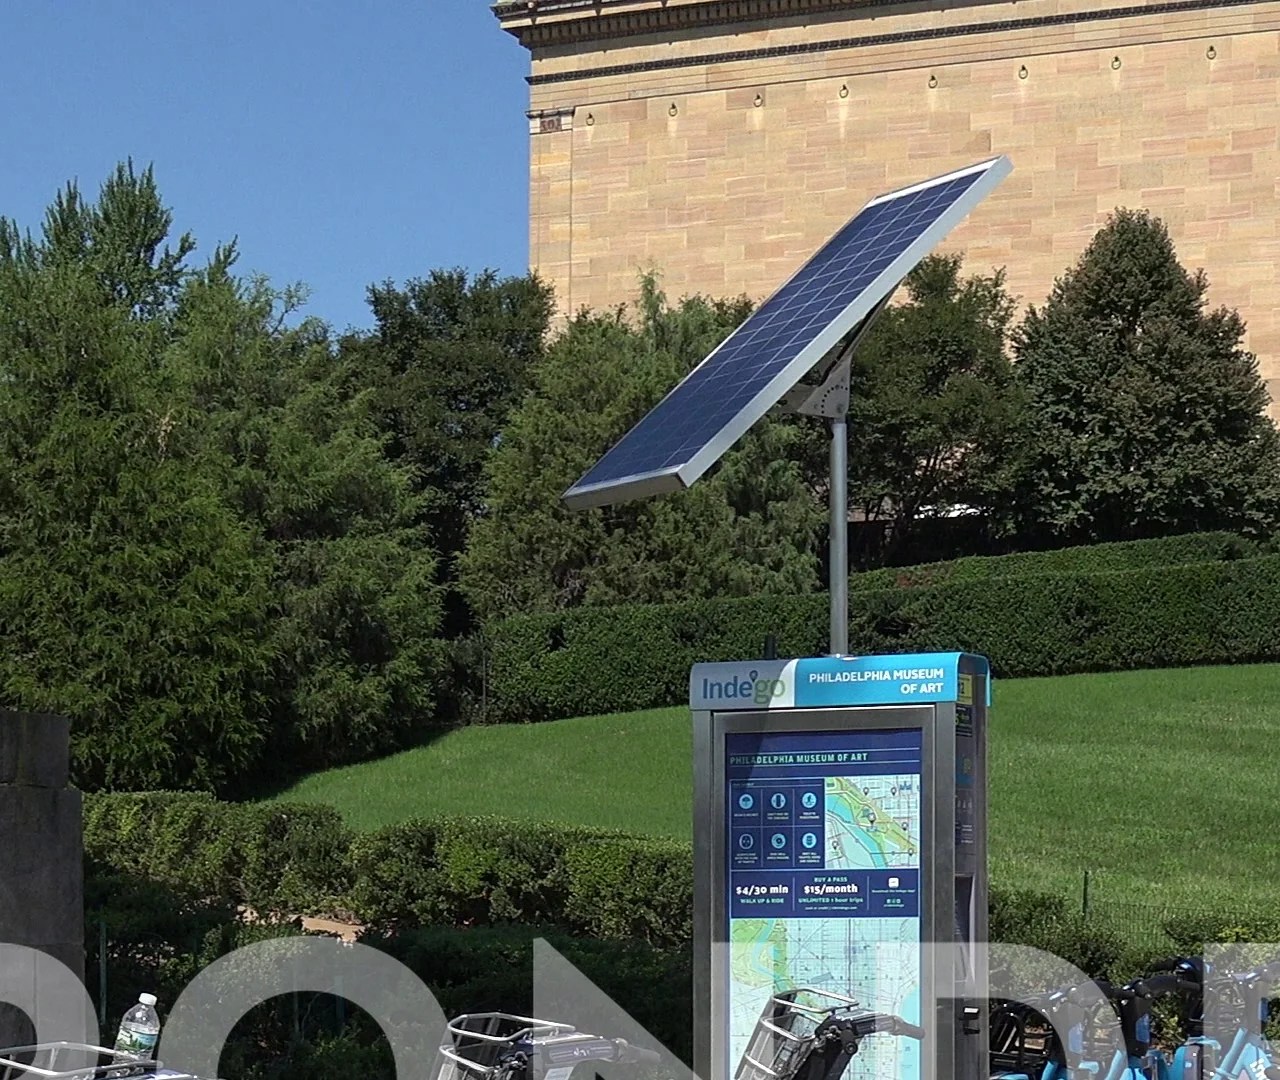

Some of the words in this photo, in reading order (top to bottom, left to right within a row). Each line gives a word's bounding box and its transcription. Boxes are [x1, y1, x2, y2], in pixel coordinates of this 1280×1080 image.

[809, 670, 892, 683] PHILADELPHIA
[893, 668, 944, 681] MUSEUM
[703, 675, 786, 704] Indego
[901, 684, 916, 694] OF
[920, 683, 944, 693] ART
[730, 755, 794, 765] PHILADELPHIA
[796, 754, 834, 763] MUSEUM
[837, 753, 848, 762] OF
[850, 753, 868, 761] ART
[736, 885, 767, 896] $4/30
[769, 884, 789, 894] min
[804, 884, 858, 895] $15/month
